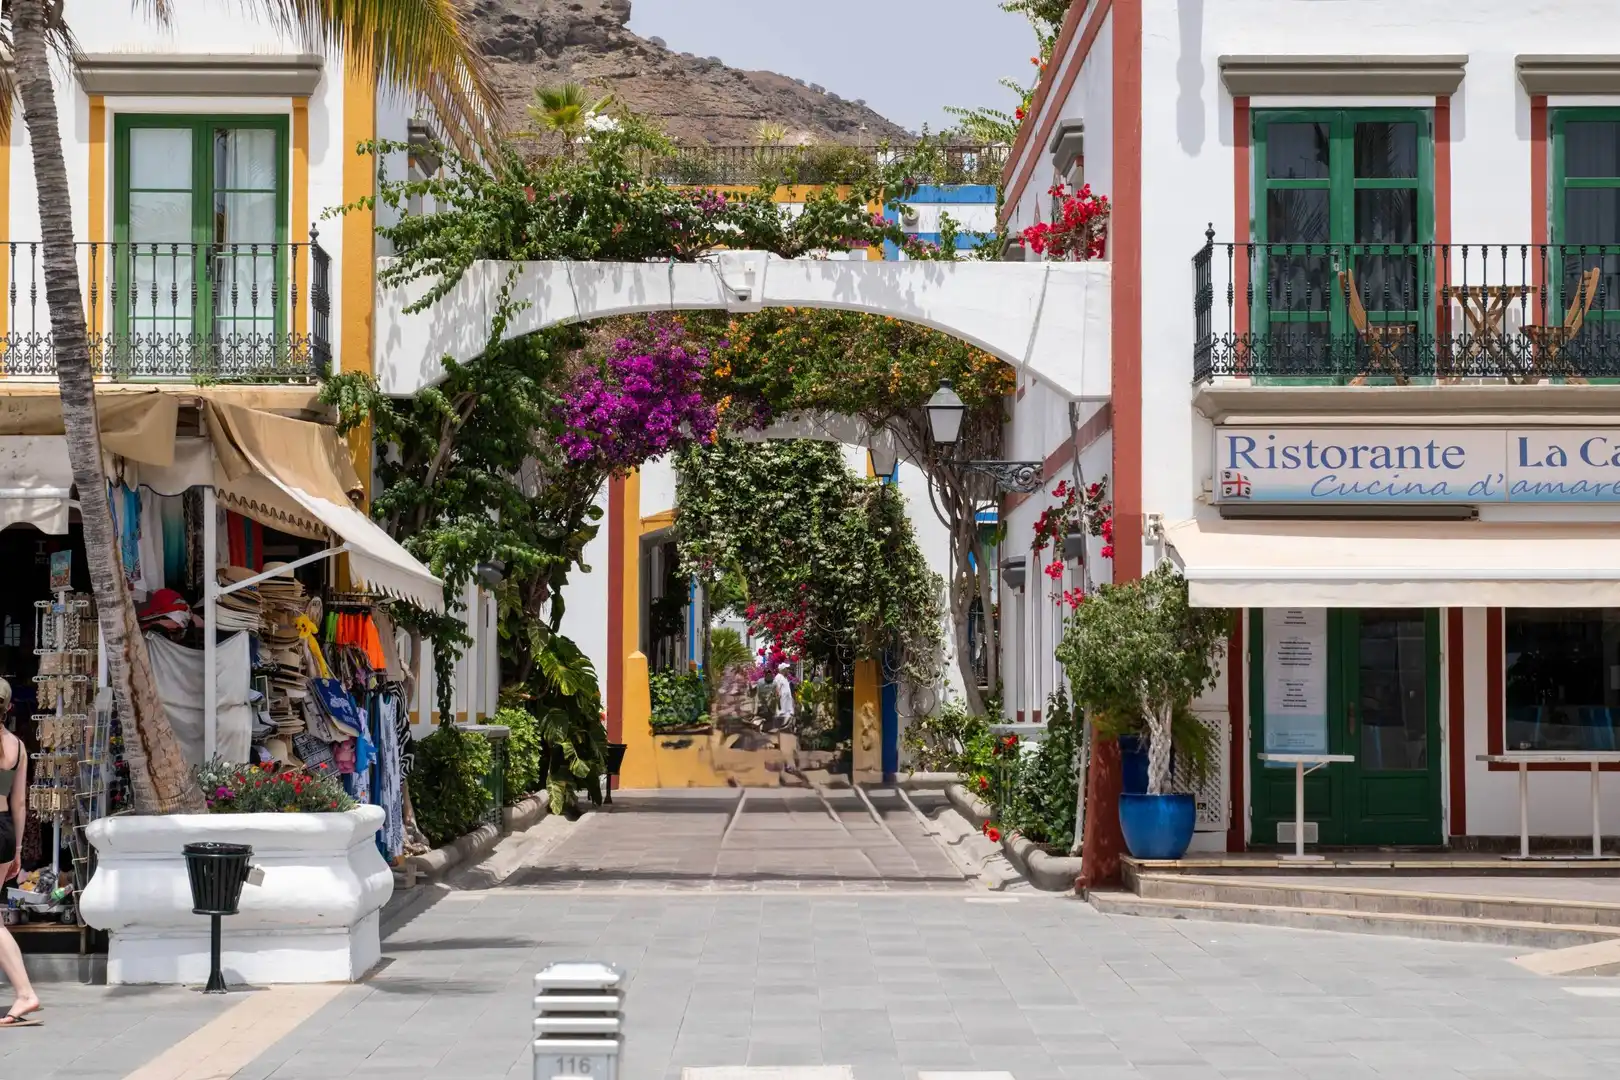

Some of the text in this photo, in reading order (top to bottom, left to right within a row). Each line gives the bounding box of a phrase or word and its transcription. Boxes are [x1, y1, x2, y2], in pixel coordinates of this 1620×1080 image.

[1225, 434, 1466, 470] Ristorante
[1518, 436, 1568, 468] La
[1310, 474, 1452, 497] Cucina
[556, 1056, 591, 1074] 116
